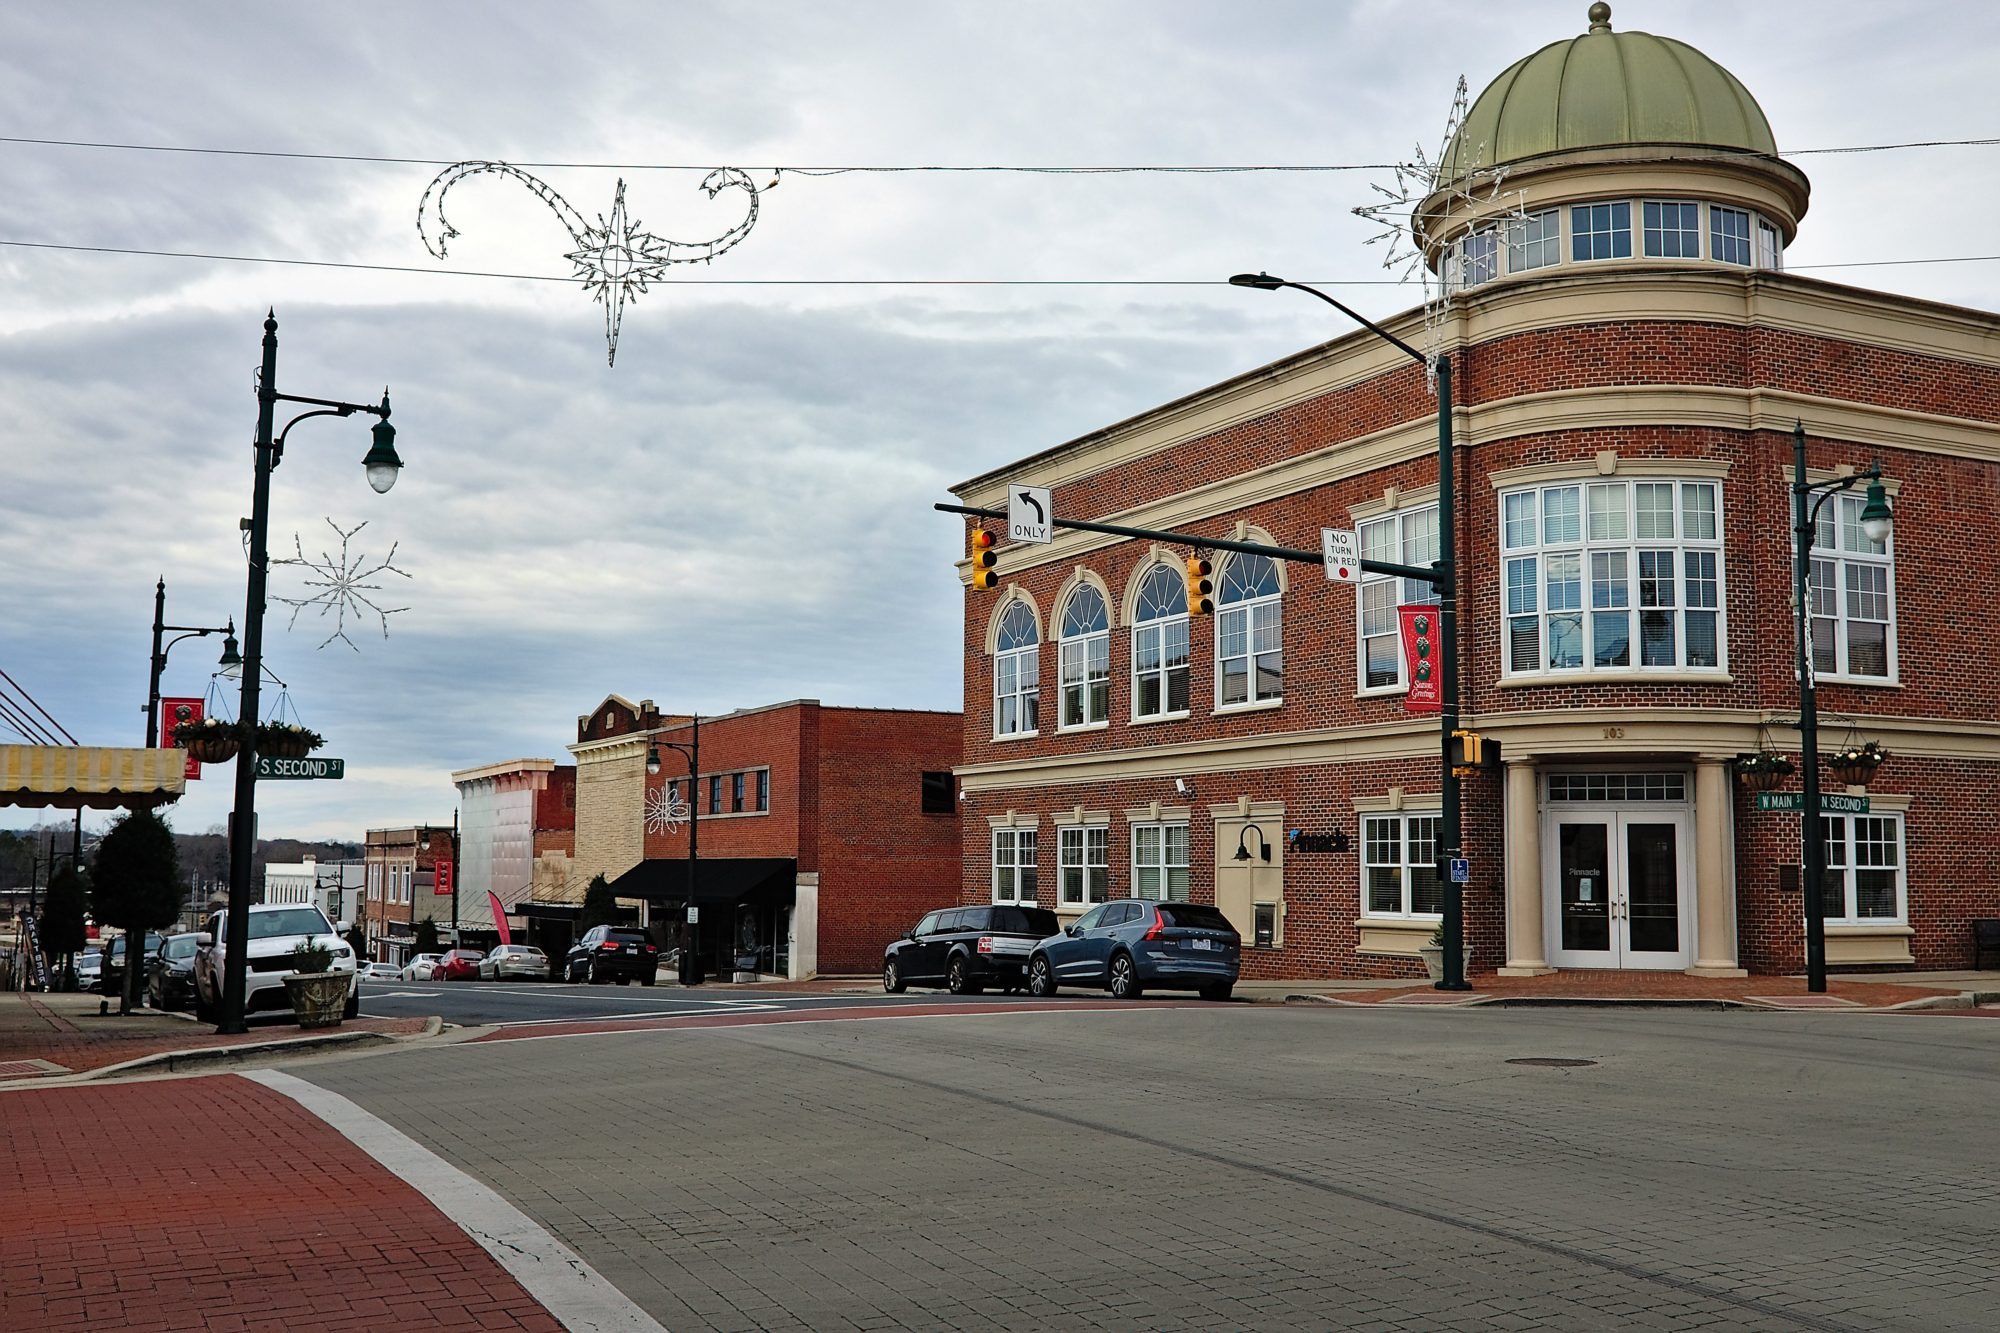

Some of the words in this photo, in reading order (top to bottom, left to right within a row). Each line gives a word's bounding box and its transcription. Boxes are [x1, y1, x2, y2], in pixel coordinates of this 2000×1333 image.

[1014, 524, 1046, 538] ONLY
[1331, 533, 1348, 544] NO
[1330, 545, 1352, 556] TURN
[1327, 555, 1339, 565] ON
[1341, 557, 1357, 567] RED
[1602, 727, 1625, 739] 103
[260, 758, 272, 775] S.
[274, 759, 327, 776] SECOND
[331, 760, 342, 771] ST
[1762, 795, 1769, 808] W
[1771, 795, 1792, 808] MAIN
[1821, 795, 1828, 808] N
[1829, 796, 1861, 811] SECOND
[1569, 868, 1600, 876] Pinnacle
